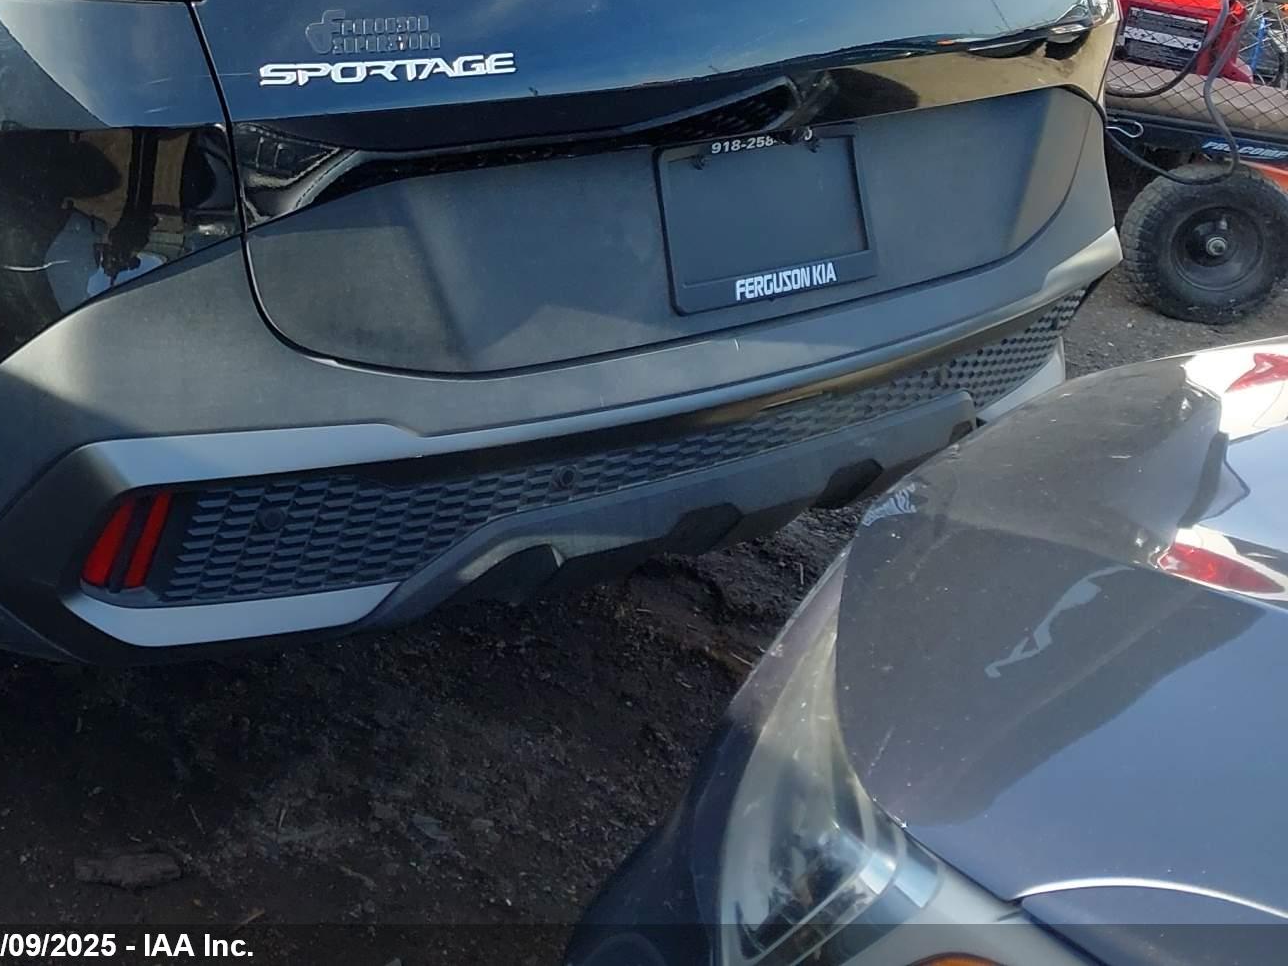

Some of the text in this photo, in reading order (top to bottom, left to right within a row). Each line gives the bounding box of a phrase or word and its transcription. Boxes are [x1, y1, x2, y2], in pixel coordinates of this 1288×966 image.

[259, 52, 516, 85] SPORTAGE
[735, 262, 837, 301] FERGUSON KIA
